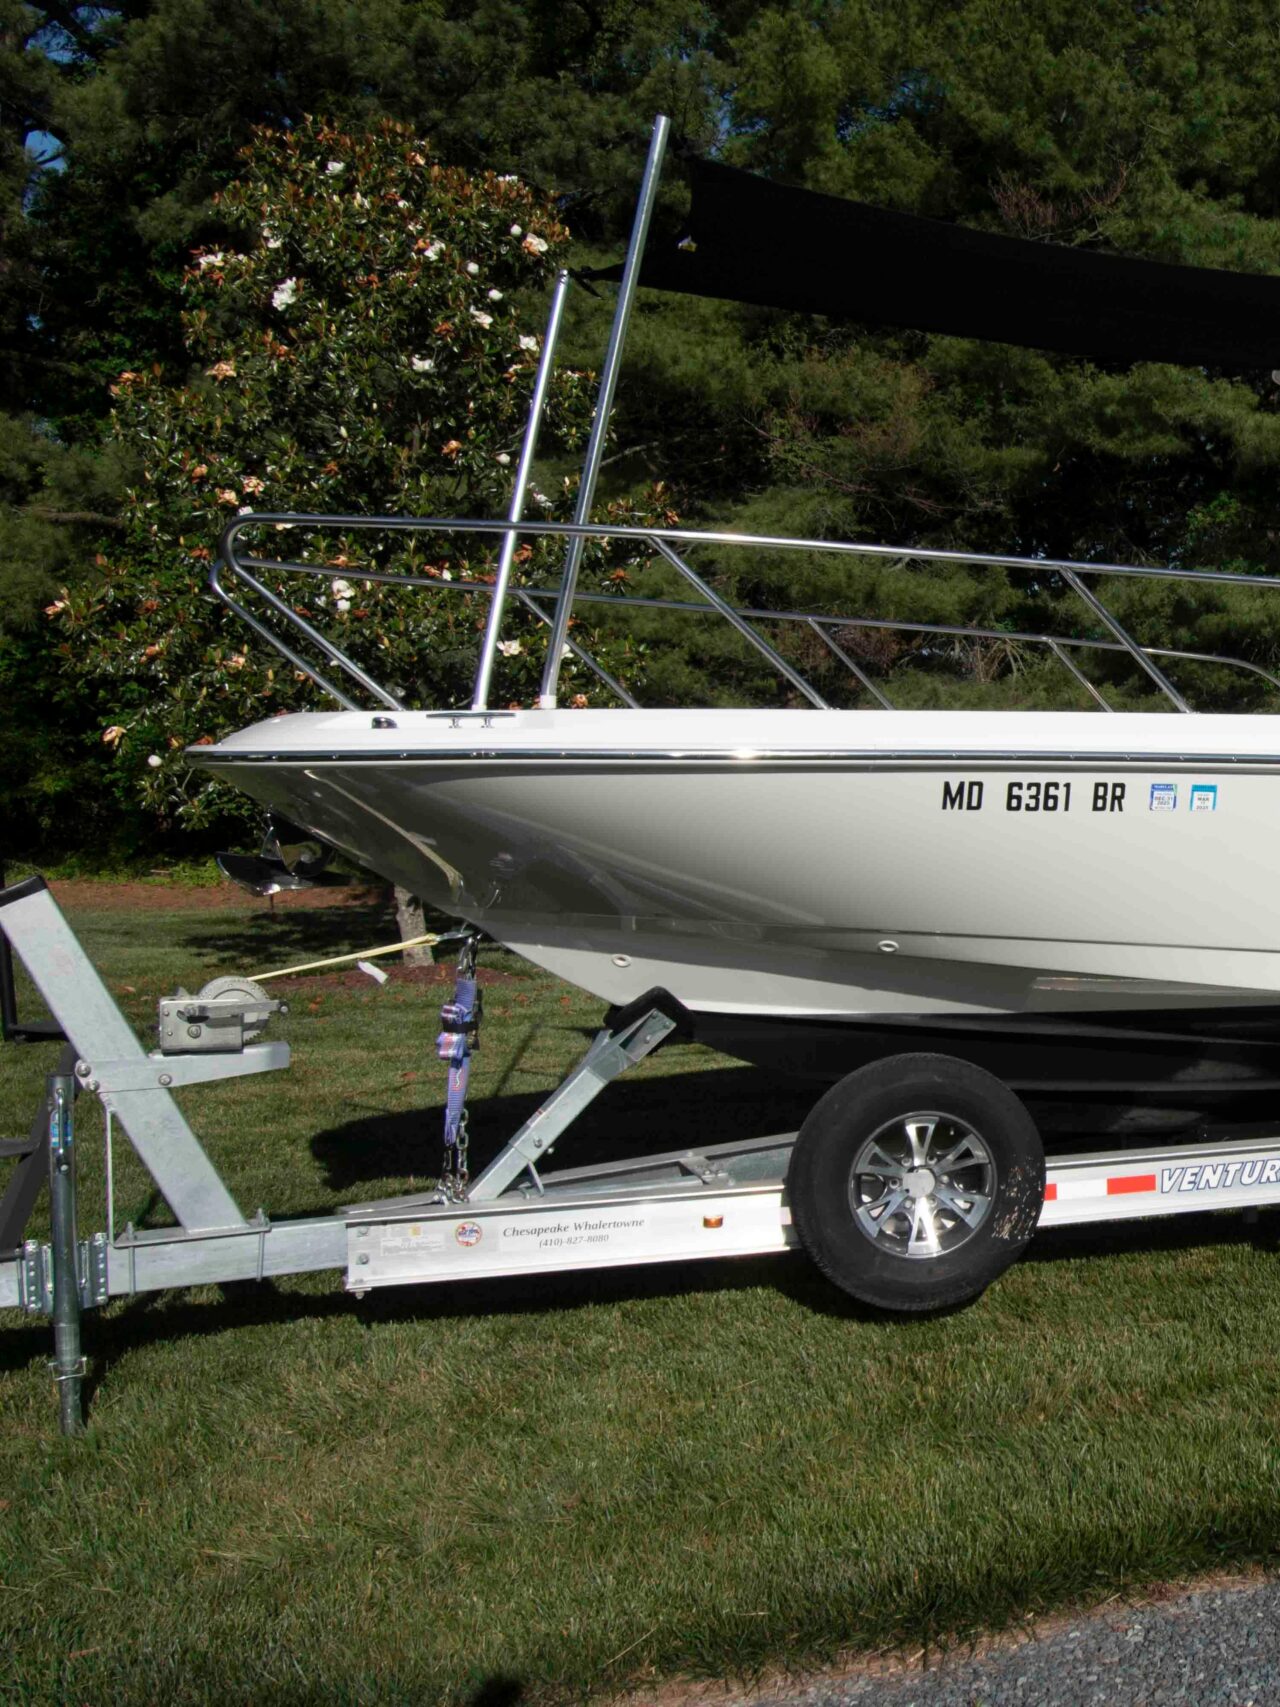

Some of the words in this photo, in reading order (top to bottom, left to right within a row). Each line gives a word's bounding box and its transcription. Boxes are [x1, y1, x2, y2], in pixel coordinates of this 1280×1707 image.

[942, 781, 984, 811] MD
[1006, 782, 1071, 812] 6361
[1092, 782, 1126, 812] BR
[502, 1222, 570, 1238] Chesapeake
[573, 1218, 645, 1232] Whalertowne
